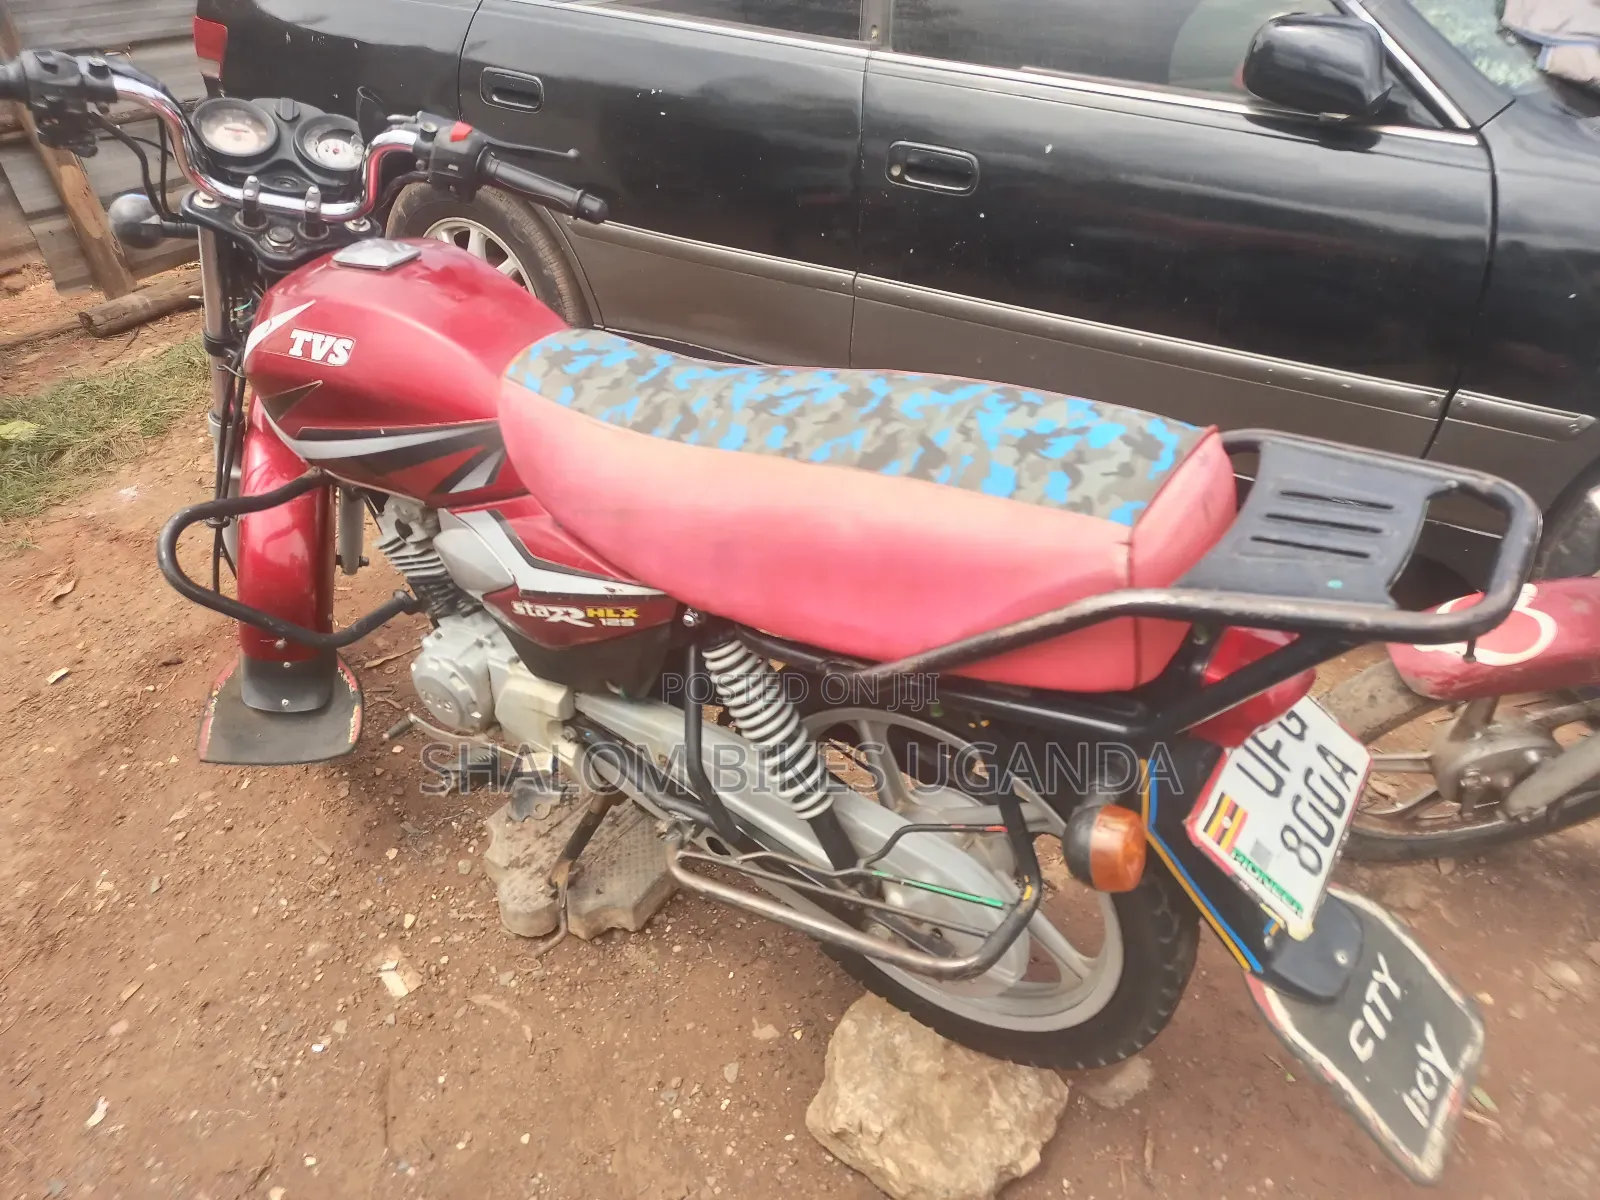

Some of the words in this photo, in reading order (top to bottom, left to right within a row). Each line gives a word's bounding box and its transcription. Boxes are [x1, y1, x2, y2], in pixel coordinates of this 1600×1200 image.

[288, 328, 354, 365] TVS
[585, 607, 640, 618] HLX
[1280, 743, 1358, 877] 800A
[1349, 952, 1401, 1063] CITY
[1401, 1020, 1456, 1129] BOY
